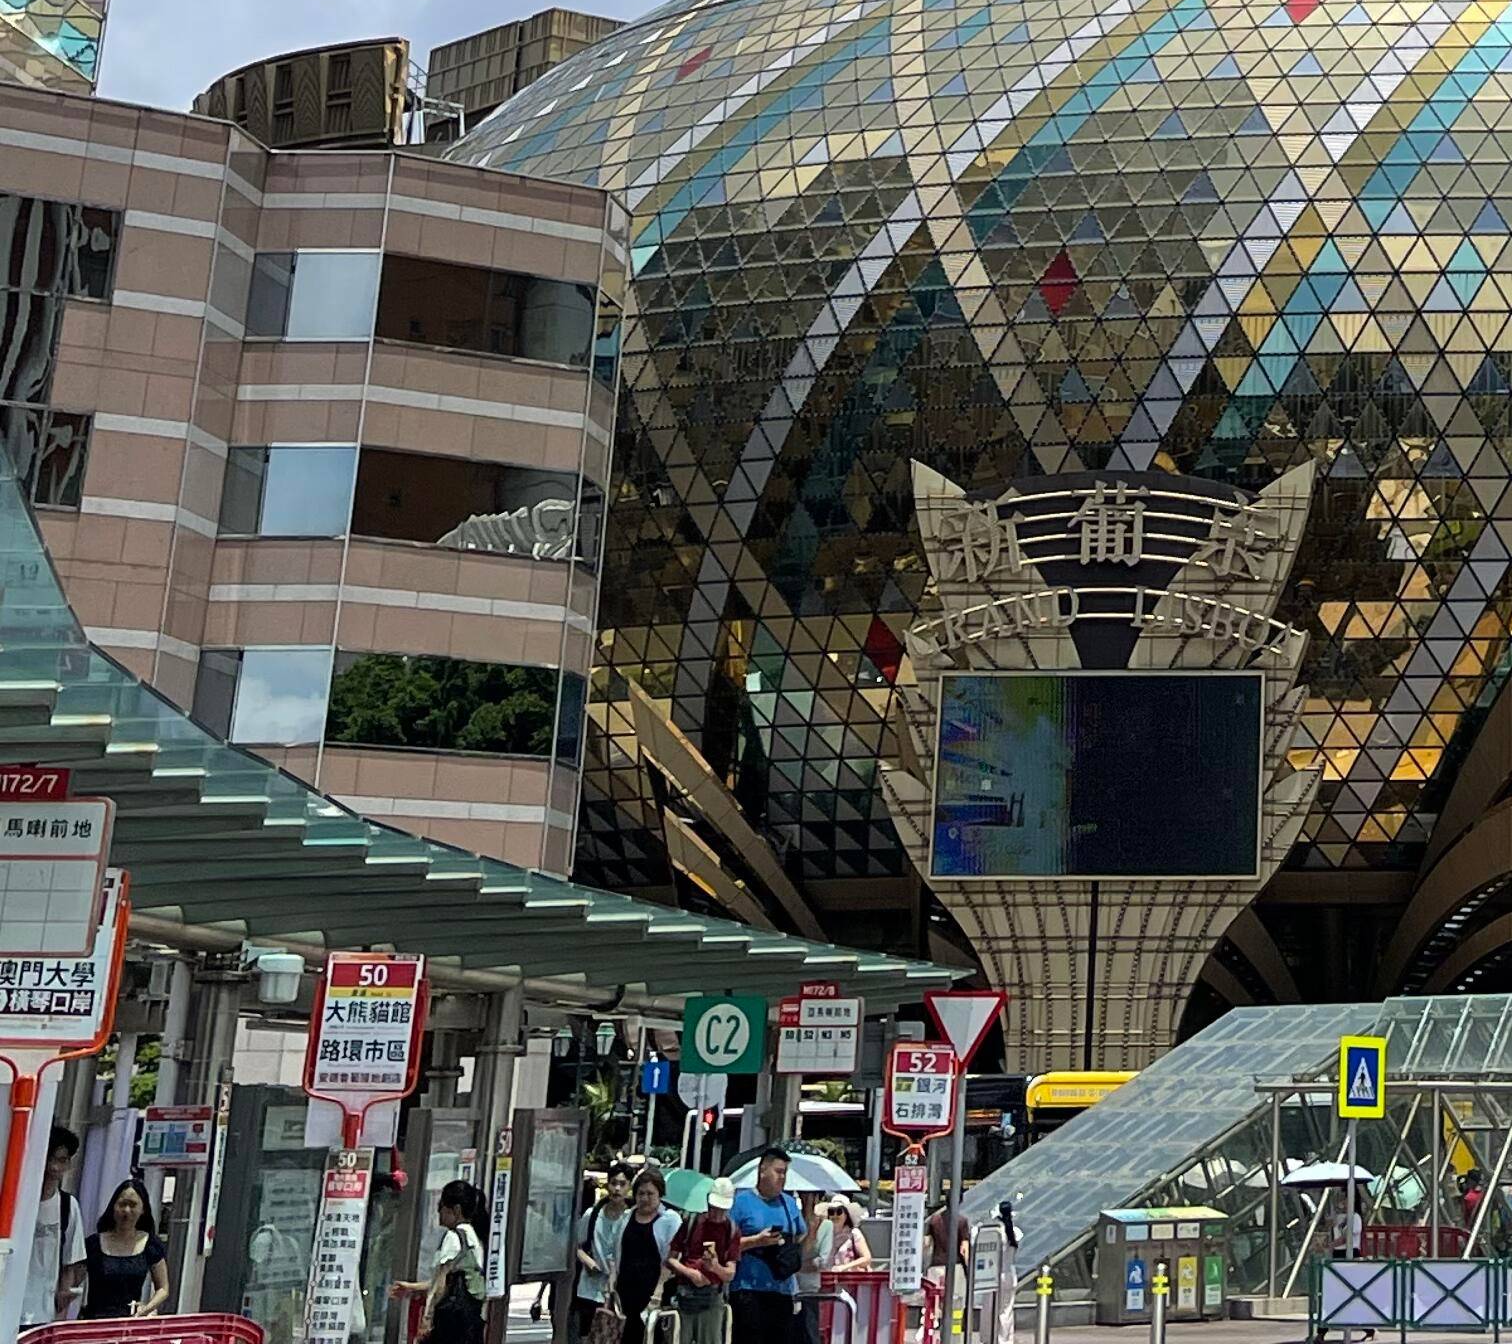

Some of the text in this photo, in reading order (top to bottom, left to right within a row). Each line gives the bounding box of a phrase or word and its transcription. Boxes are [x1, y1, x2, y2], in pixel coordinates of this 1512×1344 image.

[938, 480, 1279, 583] 新葡京
[904, 585, 1292, 665] GRAND LISBOA
[0, 774, 58, 793] 172/7
[4, 818, 92, 839] 馬喇前地
[359, 964, 388, 986] 50
[325, 1000, 412, 1024] 大熊貓館
[705, 1014, 741, 1056] C2
[319, 1039, 406, 1063] 路環市區
[909, 1053, 937, 1072] 52
[338, 1152, 357, 1167] 50
